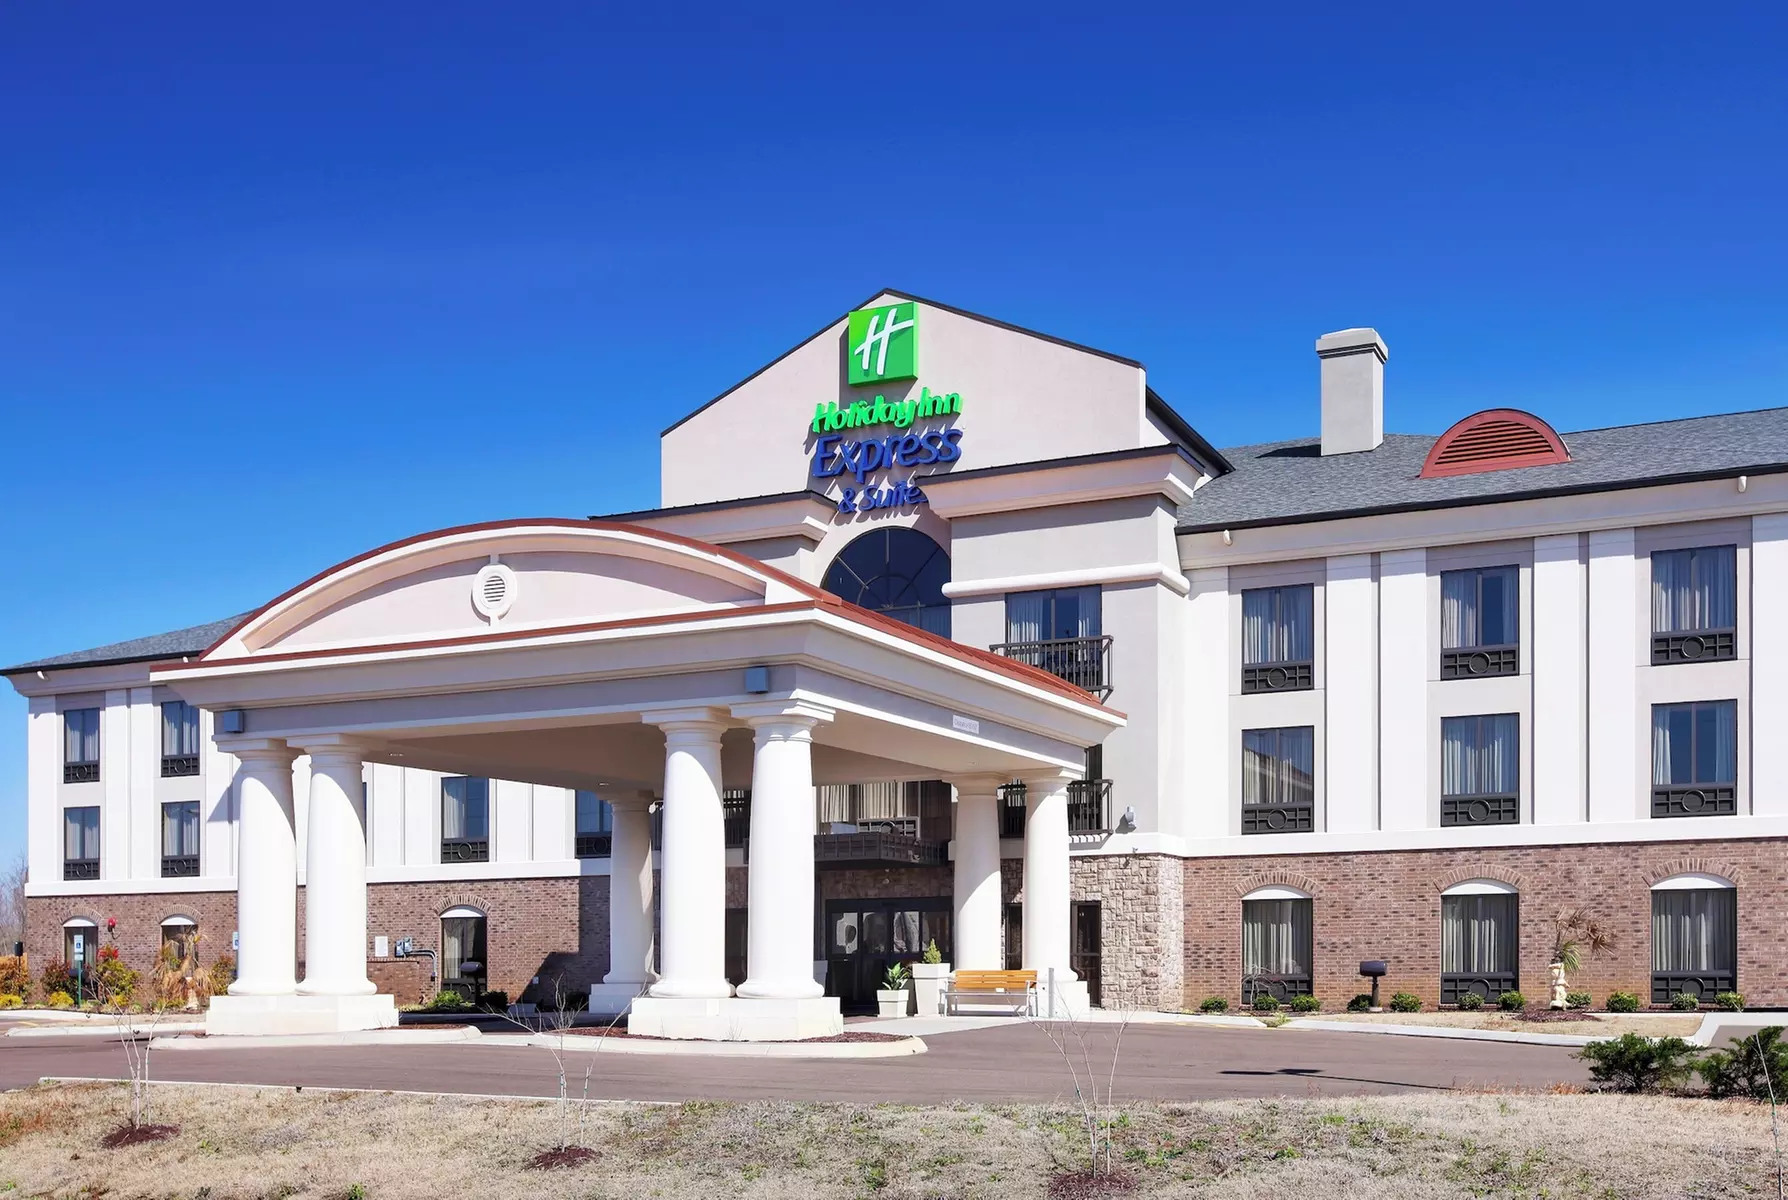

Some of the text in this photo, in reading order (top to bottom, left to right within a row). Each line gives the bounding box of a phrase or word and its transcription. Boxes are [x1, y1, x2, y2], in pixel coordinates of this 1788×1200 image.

[854, 308, 914, 376] H
[812, 387, 963, 433] Holiday Inn
[812, 429, 964, 484] Express
[837, 480, 928, 514] & Suite
